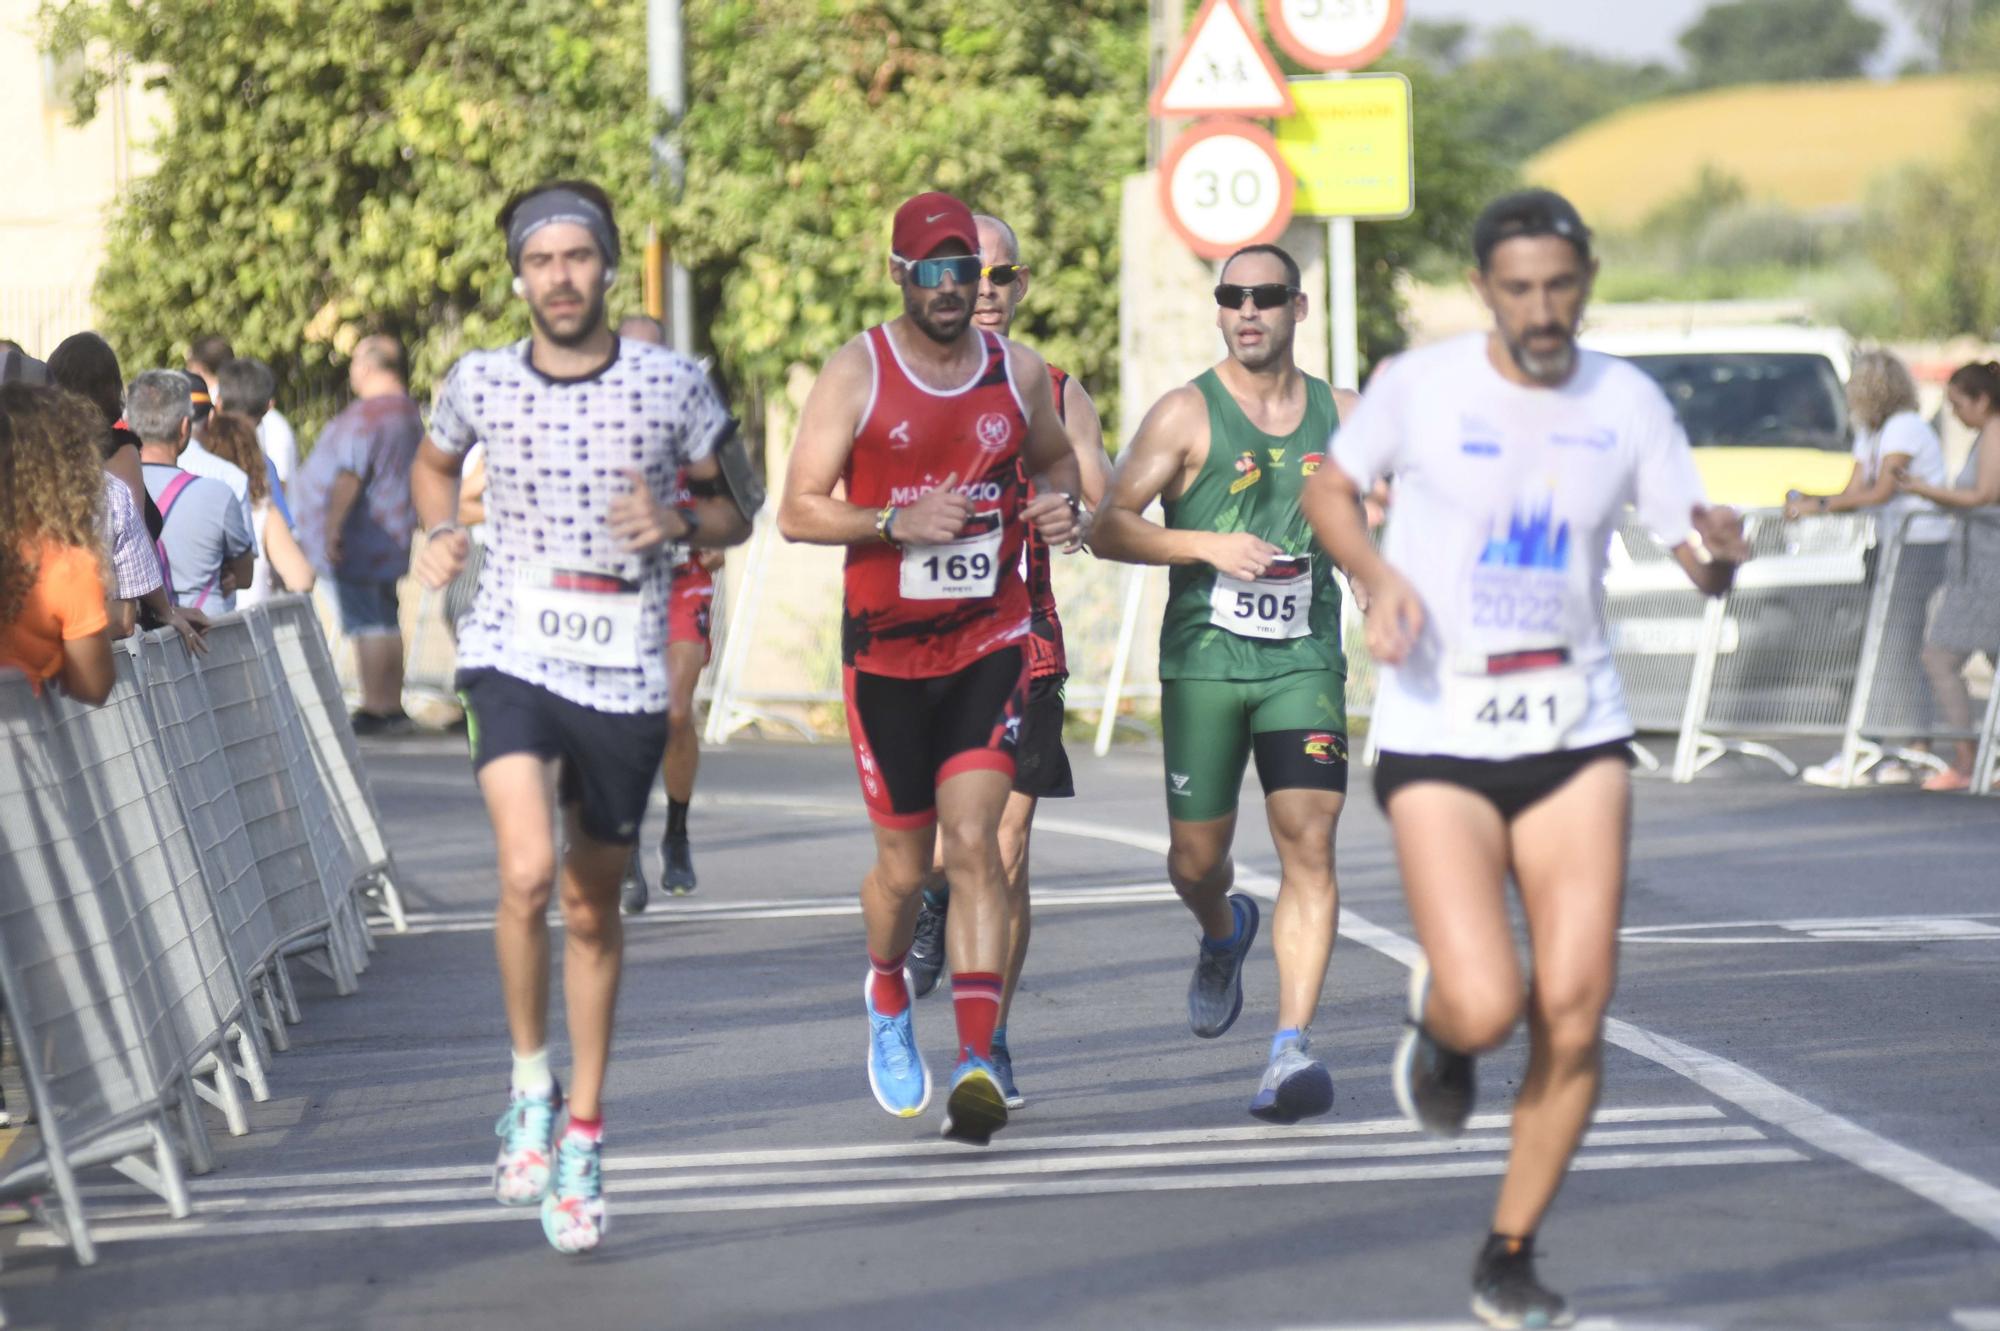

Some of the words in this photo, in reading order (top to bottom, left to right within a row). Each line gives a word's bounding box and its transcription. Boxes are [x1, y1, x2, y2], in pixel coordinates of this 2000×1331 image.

[1194, 169, 1261, 207] 30
[922, 553, 991, 581] 169
[1233, 591, 1297, 622] 505
[1472, 592, 1563, 632] 2022
[538, 608, 613, 645] 090
[1476, 694, 1557, 726] 441
